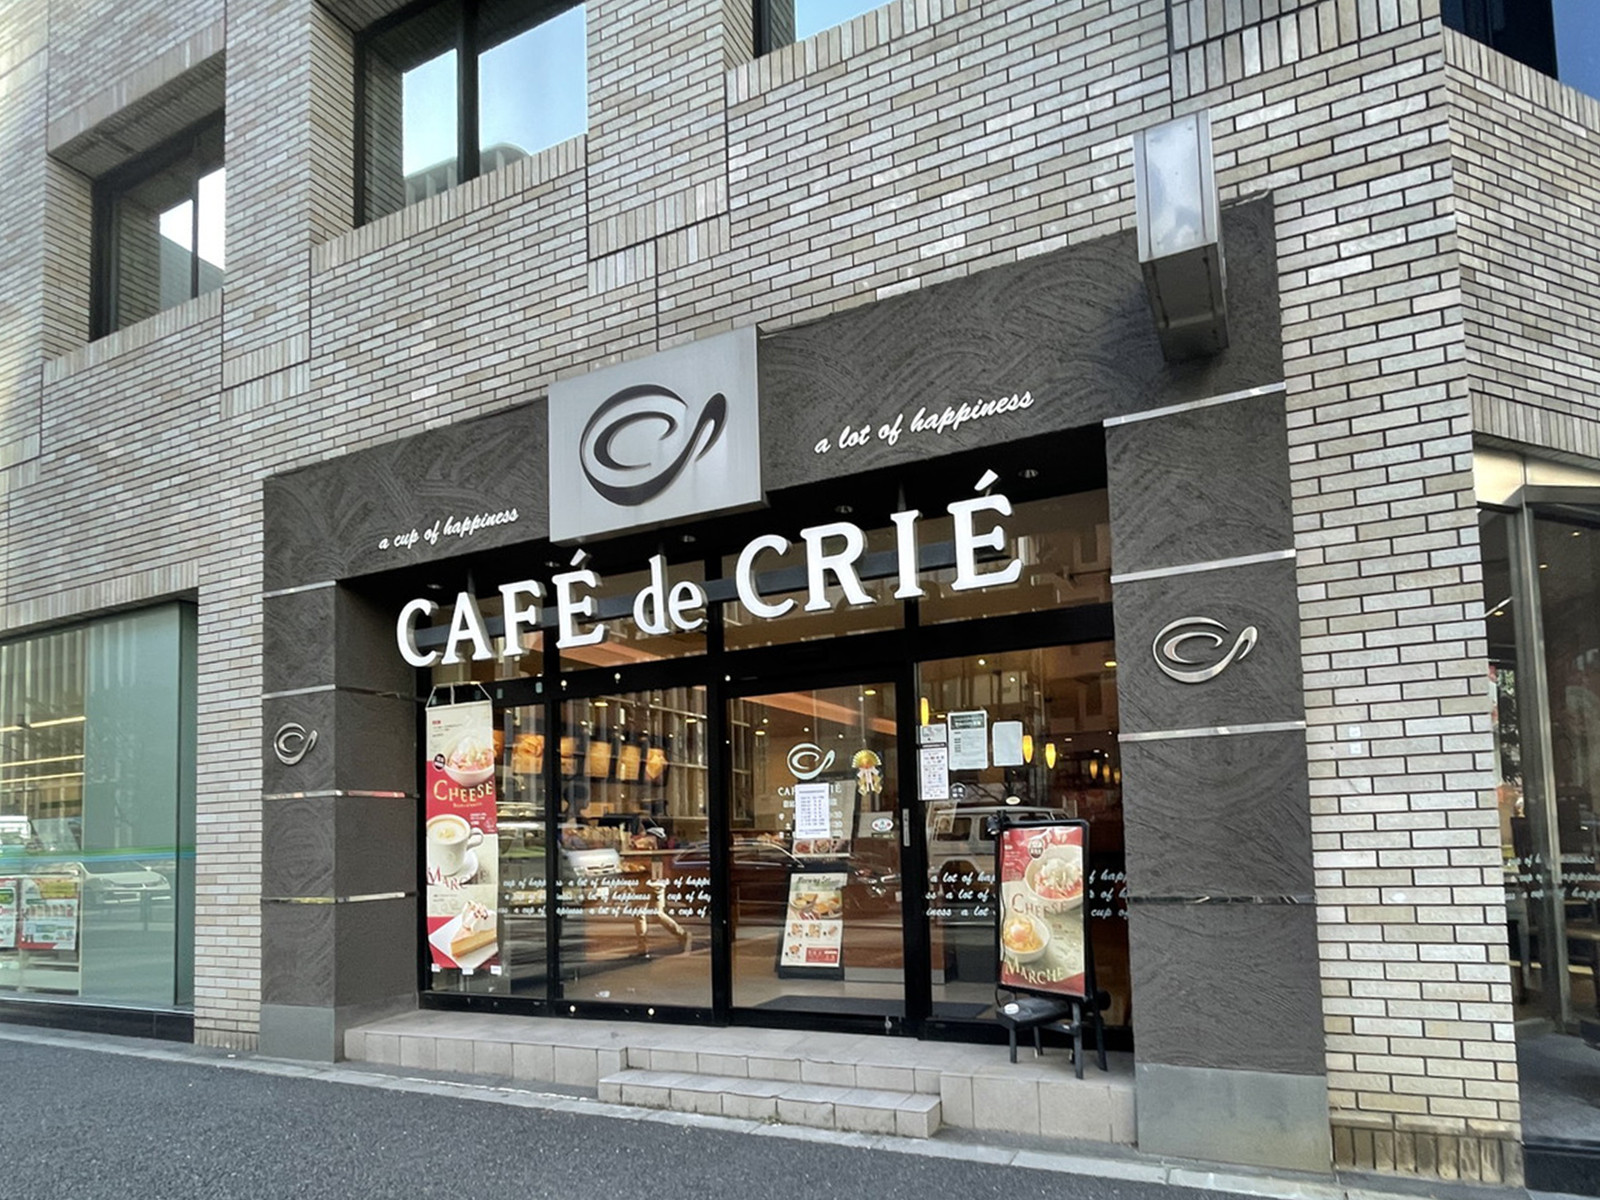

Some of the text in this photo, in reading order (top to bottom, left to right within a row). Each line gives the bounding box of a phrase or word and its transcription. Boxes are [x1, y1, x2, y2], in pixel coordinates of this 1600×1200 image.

[814, 390, 1035, 454] a lot of happiness
[378, 507, 519, 550] a cup of happiness
[396, 468, 1023, 668] CAFÉ de CRIÉ
[433, 779, 494, 803] CHEESE
[601, 877, 639, 889] happiness
[673, 876, 683, 888] of
[930, 875, 938, 883] a
[942, 871, 958, 883] lot
[961, 871, 974, 886] of
[612, 890, 651, 902] happiness
[667, 893, 682, 902] cup
[685, 890, 695, 903] of
[945, 892, 953, 900] a
[958, 888, 974, 900] lot
[977, 887, 990, 903] of
[1100, 887, 1114, 902] of
[678, 907, 694, 917] cup
[696, 905, 708, 918] of
[973, 905, 990, 917] lot
[1011, 892, 1068, 918] CHEESE
[1091, 907, 1113, 919] cup
